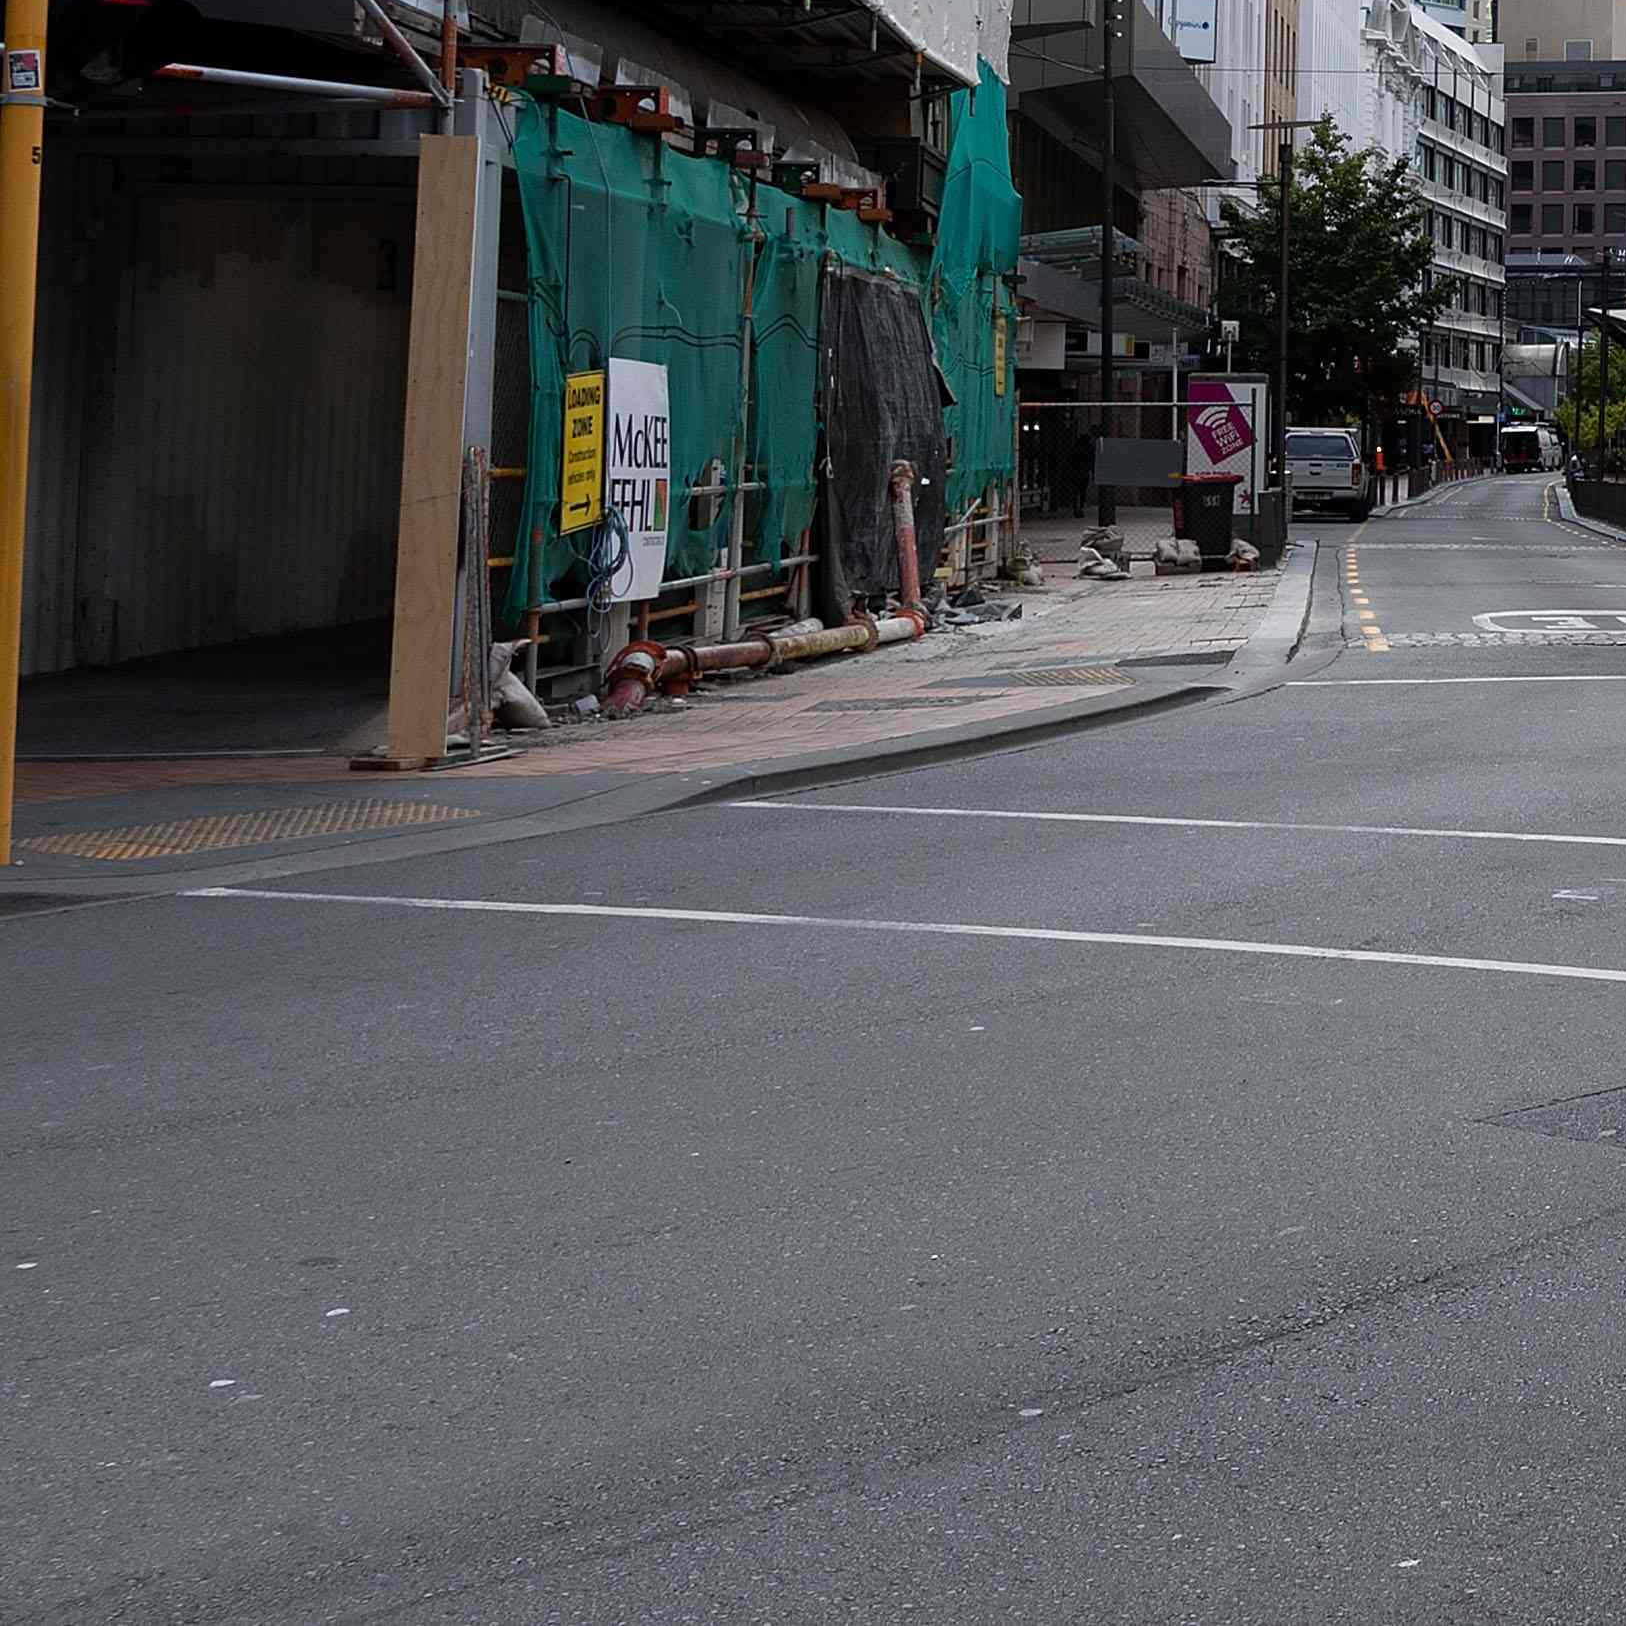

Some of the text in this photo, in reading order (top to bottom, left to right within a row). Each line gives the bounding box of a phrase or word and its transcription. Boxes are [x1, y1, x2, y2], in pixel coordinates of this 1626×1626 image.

[568, 386, 600, 410] LOADING
[572, 416, 593, 439] ZONE
[612, 413, 667, 468] McKEE
